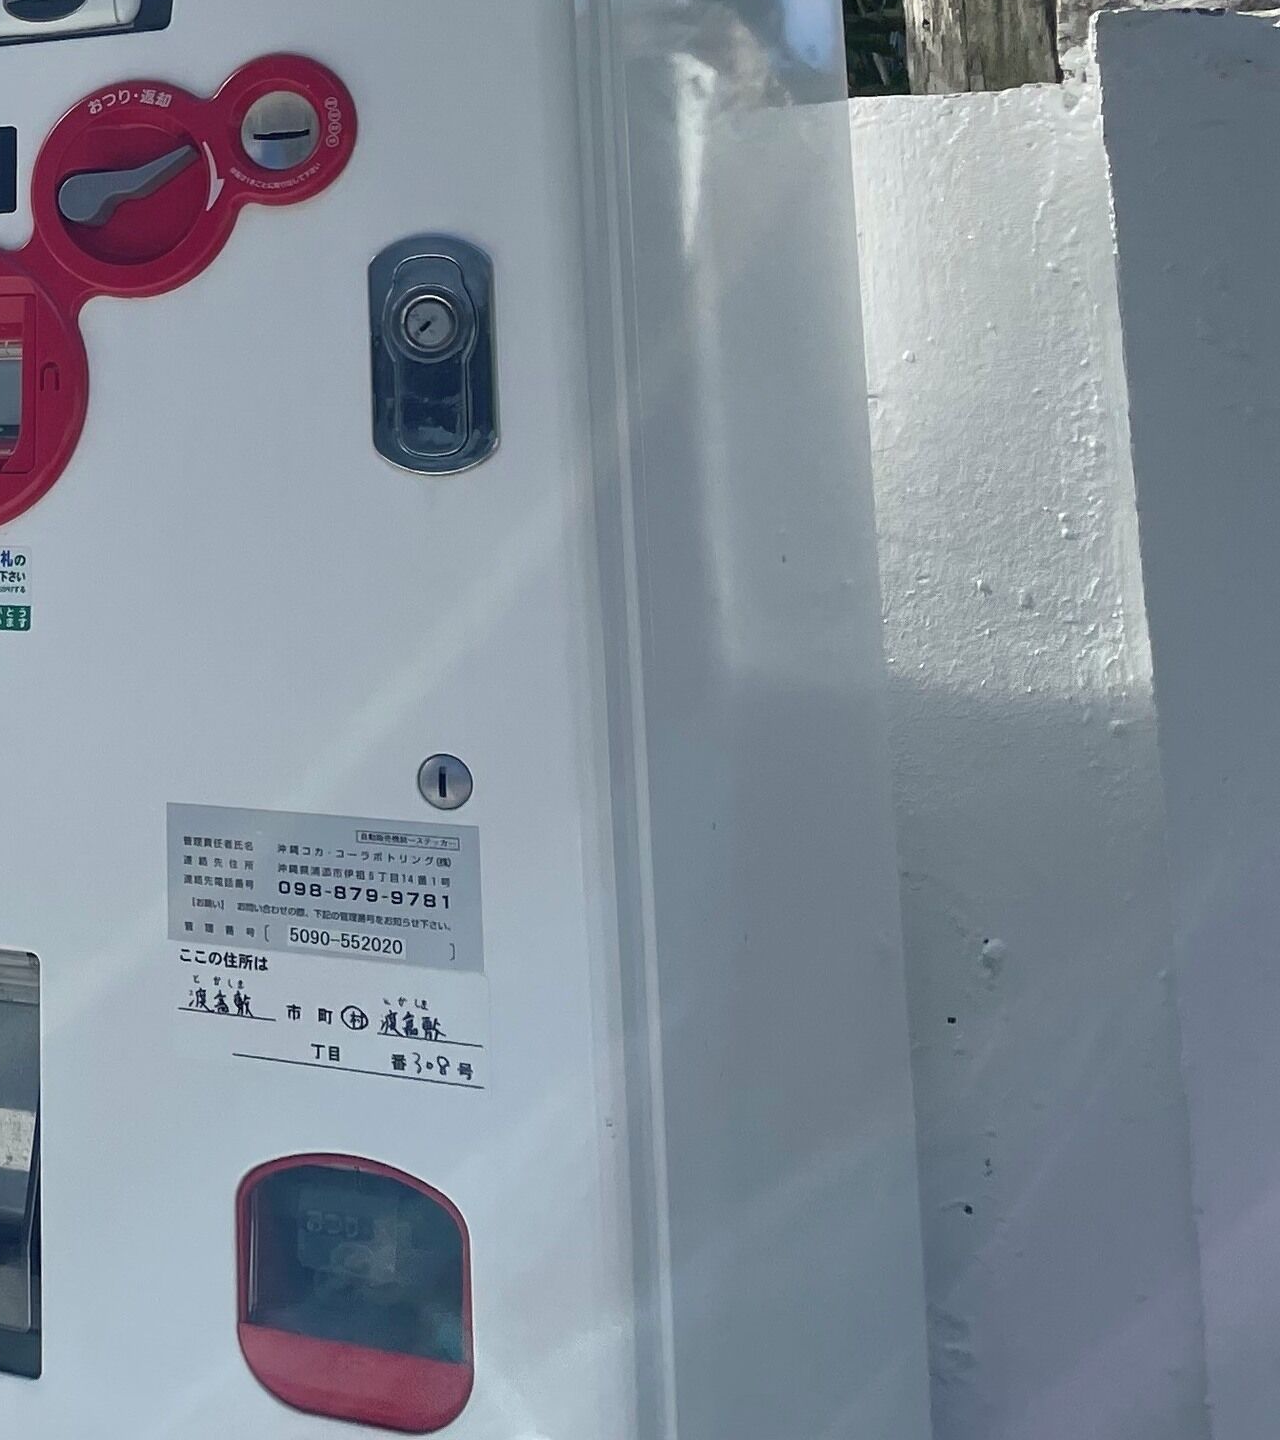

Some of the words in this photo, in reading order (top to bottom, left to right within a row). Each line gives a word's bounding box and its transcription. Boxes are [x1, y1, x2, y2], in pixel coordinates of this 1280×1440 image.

[86, 86, 173, 116] おつり・返却
[278, 880, 451, 910] 098-879-9781
[290, 928, 403, 955] 5090-552020
[179, 948, 269, 972] ここの住所は
[311, 1043, 341, 1062] 丁目
